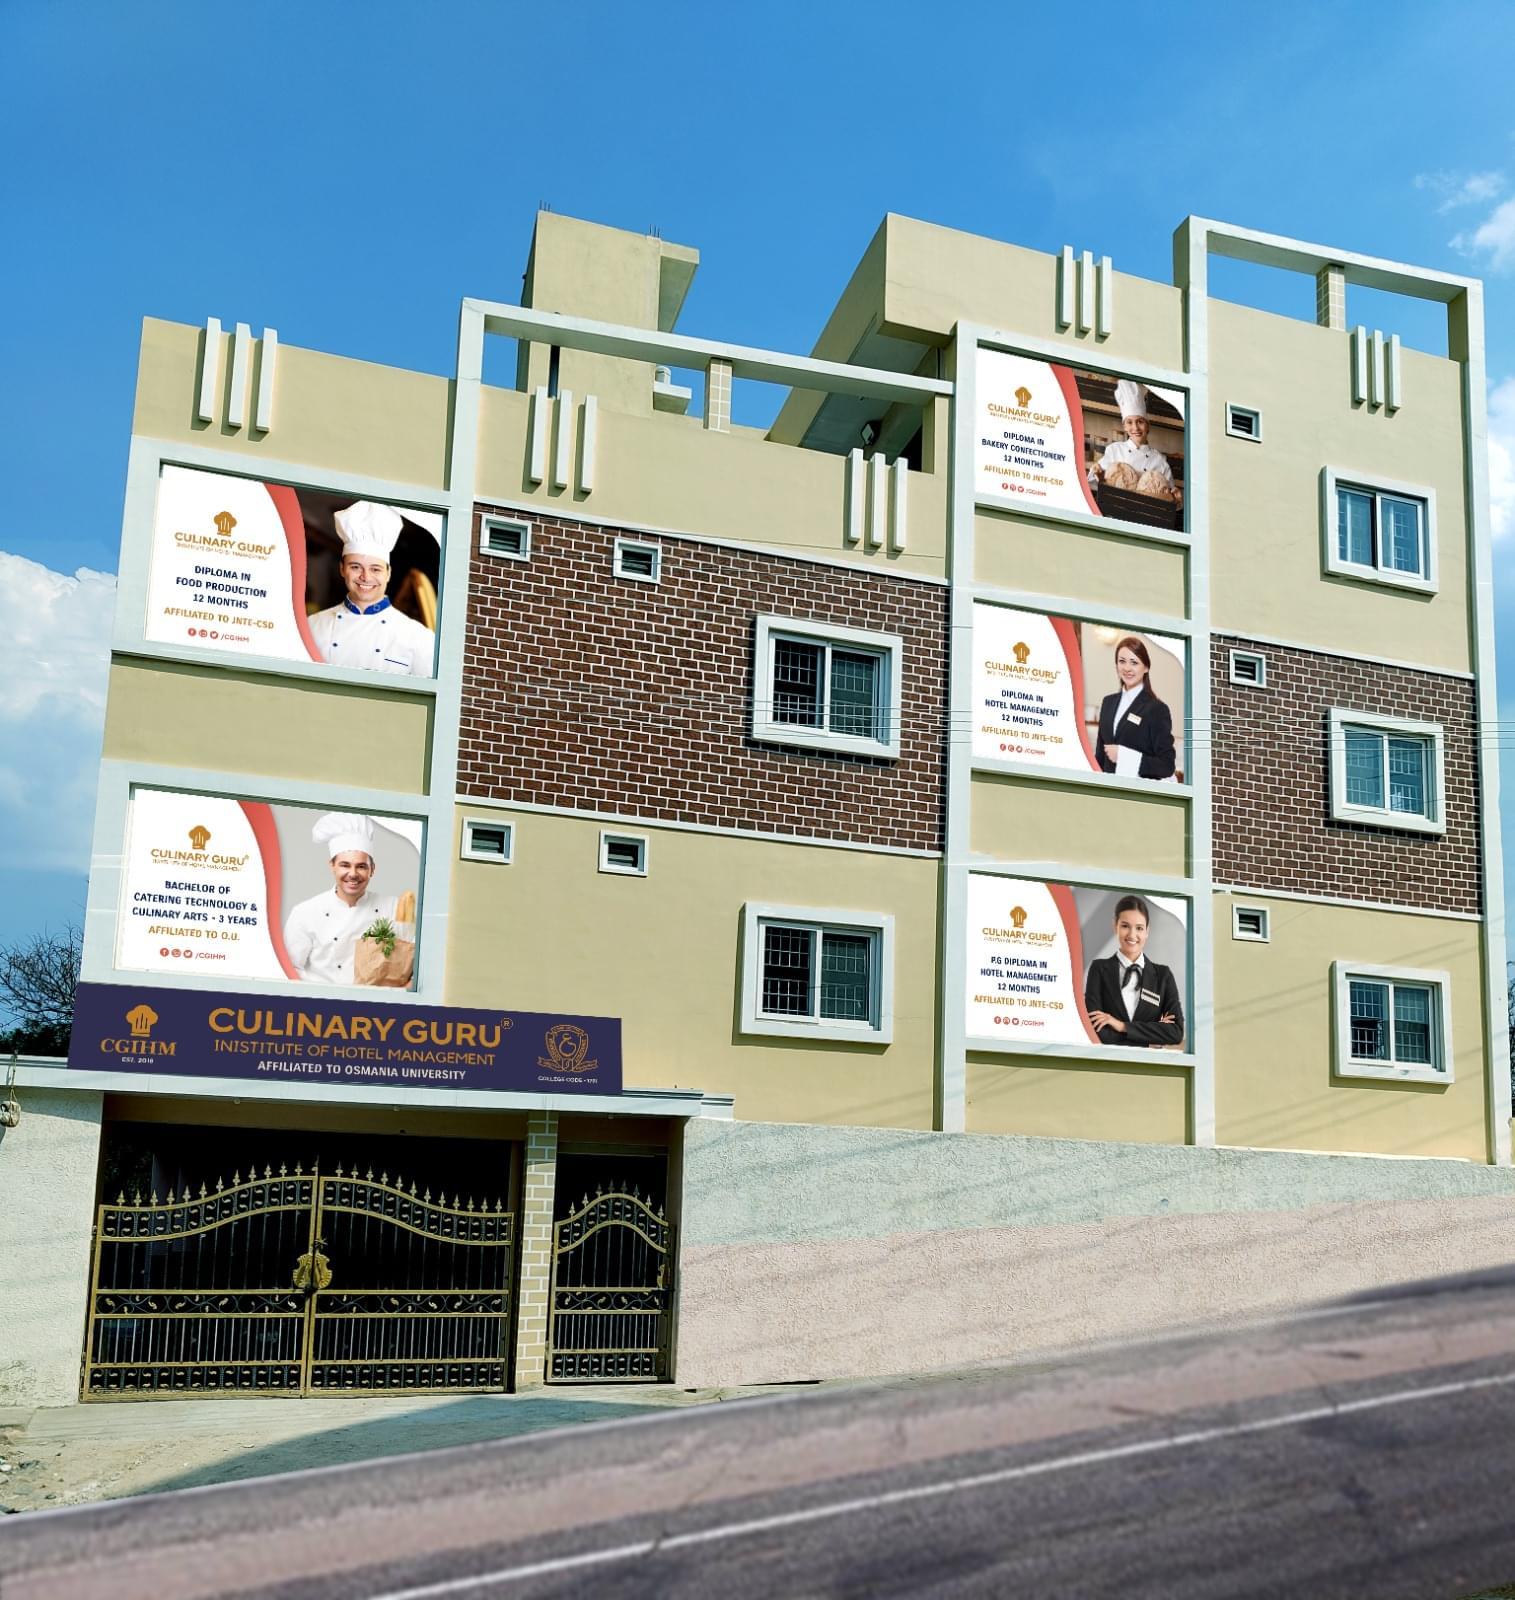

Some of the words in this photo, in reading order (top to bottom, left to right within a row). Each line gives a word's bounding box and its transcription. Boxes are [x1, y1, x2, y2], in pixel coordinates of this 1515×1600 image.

[988, 403, 1032, 419] CULINARY
[1003, 432, 1035, 444] DIPLOMA
[982, 439, 1008, 450] BAKERY
[1011, 445, 1065, 461] CONFECTIONERY
[1014, 456, 1044, 468] MONTHS
[984, 465, 1020, 477] AFFILIATED
[174, 532, 236, 549] CULINARY
[195, 566, 238, 579] DIPLOMA
[241, 573, 251, 581] IN
[176, 577, 202, 588] FOOD
[206, 582, 266, 598] PRODUCTION
[193, 594, 204, 602] 12
[208, 596, 248, 609] MONTHS
[164, 607, 214, 621] AFFILIATED
[218, 614, 229, 623] TO
[232, 616, 274, 629] JNTE-CSD
[985, 661, 1030, 674] CULINARY
[1001, 690, 1033, 701] DIPLOMA
[985, 699, 1007, 709] HOTEL
[1010, 703, 1059, 717] MANAGEMENT
[1013, 716, 1043, 726] MONTHS
[982, 725, 1019, 737] AFFILIATED
[151, 848, 209, 862] CULINARY
[165, 881, 215, 893] BACHELOR
[218, 886, 231, 894] OF
[134, 892, 181, 905] CATERING
[185, 897, 248, 911] TECHNOLOGY
[250, 903, 257, 911] &
[132, 907, 180, 918] CULINARY
[183, 912, 208, 921] ARTS
[219, 915, 224, 923] 3
[228, 916, 257, 926] YEARS
[148, 926, 202, 938] AFFILIATED
[222, 932, 240, 940] O.U.
[982, 927, 1027, 939] CULINARY
[195, 952, 226, 960] /CGIHM
[991, 956, 1001, 964] P.G
[1004, 957, 1037, 968] DIPLOMA
[981, 968, 1004, 977] HOTEL
[1006, 970, 1057, 982] MANAGEMENT
[1009, 984, 1040, 993] MONTHS
[974, 995, 1014, 1006] AFFILIATED
[1017, 999, 1027, 1007] TO
[208, 1007, 398, 1041] CULINARY
[100, 1038, 177, 1056] CGIHM
[214, 1039, 303, 1057] INISTITUTE
[307, 1044, 330, 1058] OF
[333, 1046, 383, 1061] HOTEL
[387, 1049, 496, 1066] MANAGEMENT
[257, 1060, 322, 1074] AFFILIATED
[326, 1063, 341, 1075] TO
[344, 1064, 398, 1077] OSMANIA
[402, 1067, 466, 1081] UNIVERSITY
